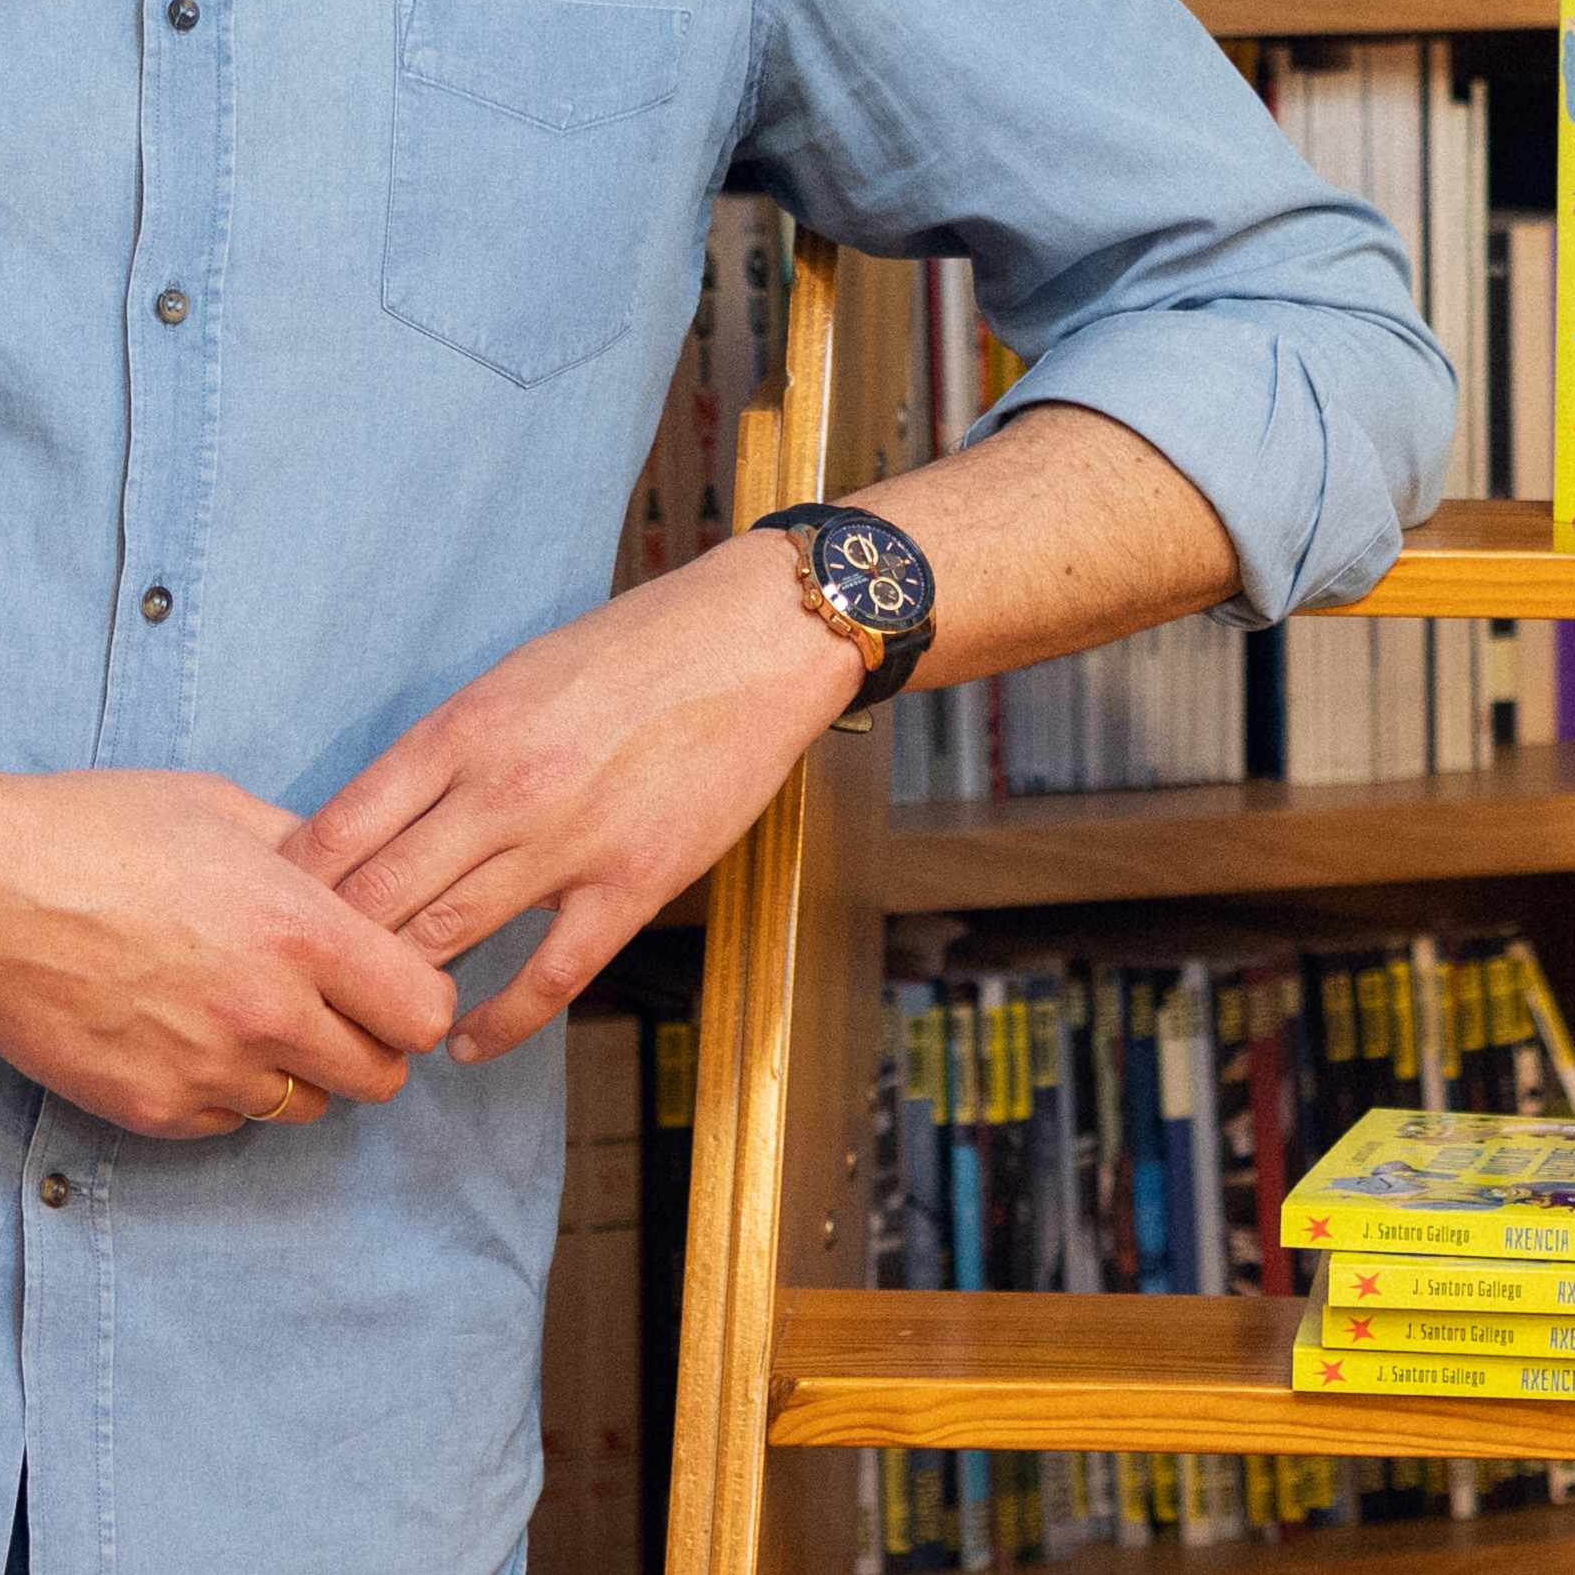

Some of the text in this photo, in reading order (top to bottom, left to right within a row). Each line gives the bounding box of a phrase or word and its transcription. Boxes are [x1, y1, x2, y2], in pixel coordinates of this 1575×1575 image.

[1363, 1223, 1371, 1240] J.
[1378, 1223, 1423, 1242] Santoro
[1427, 1225, 1470, 1246] Gallego
[1505, 1227, 1569, 1253] AXENCIA
[1413, 1279, 1422, 1296] J.
[1428, 1280, 1473, 1299] Santoro
[1478, 1281, 1522, 1301] Gallego
[1406, 1323, 1415, 1340] J.
[1420, 1324, 1466, 1343] Santoro
[1471, 1326, 1514, 1346] Gallego
[1377, 1365, 1386, 1382] J.
[1392, 1366, 1438, 1384] Santoro
[1442, 1367, 1485, 1387] Gallego
